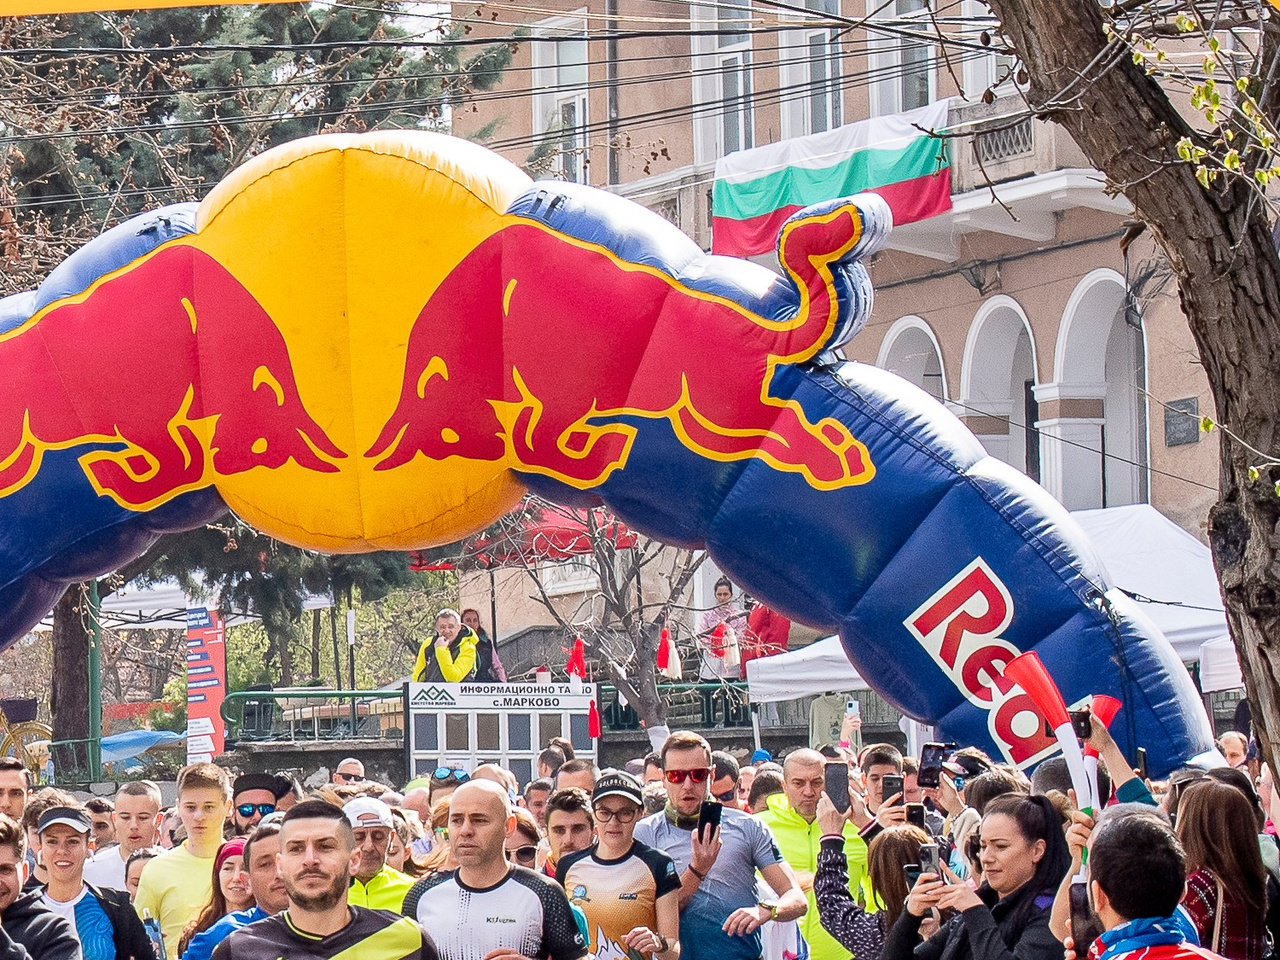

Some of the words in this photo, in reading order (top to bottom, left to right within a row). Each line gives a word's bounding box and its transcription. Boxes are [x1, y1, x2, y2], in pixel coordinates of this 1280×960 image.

[903, 555, 1070, 771] Red
[460, 685, 555, 695] ИНФОРМАЦИОННО
[558, 685, 592, 694] ТАО
[493, 698, 560, 707] с.МАРКОВО
